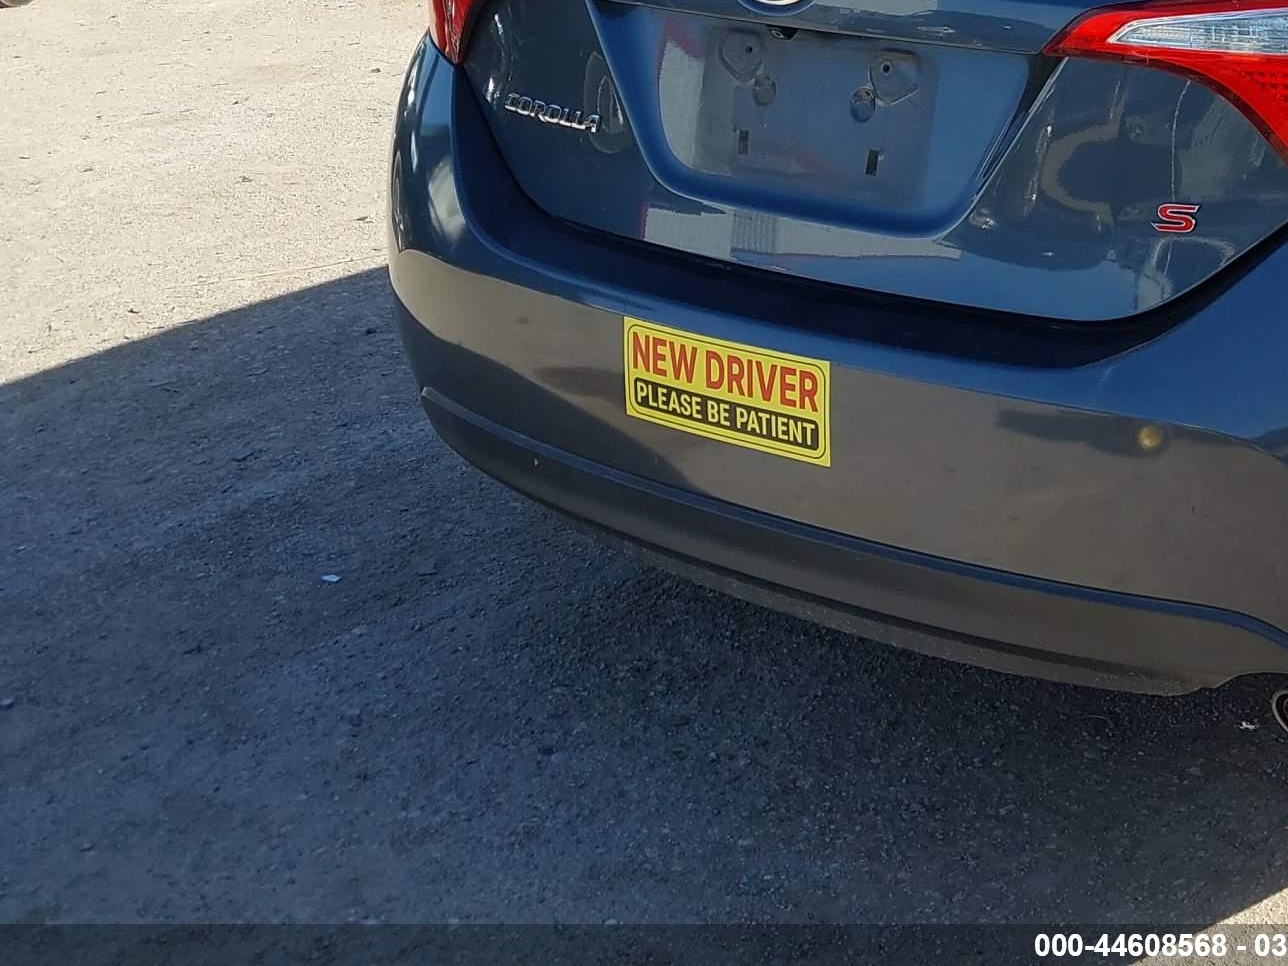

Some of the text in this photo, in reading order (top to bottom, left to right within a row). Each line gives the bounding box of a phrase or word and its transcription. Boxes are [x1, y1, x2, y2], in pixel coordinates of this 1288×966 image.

[505, 93, 600, 133] COROLLA
[1150, 203, 1200, 233] S
[632, 331, 819, 412] NEW DRIVER
[636, 381, 816, 446] PLEASE BE PATIENT
